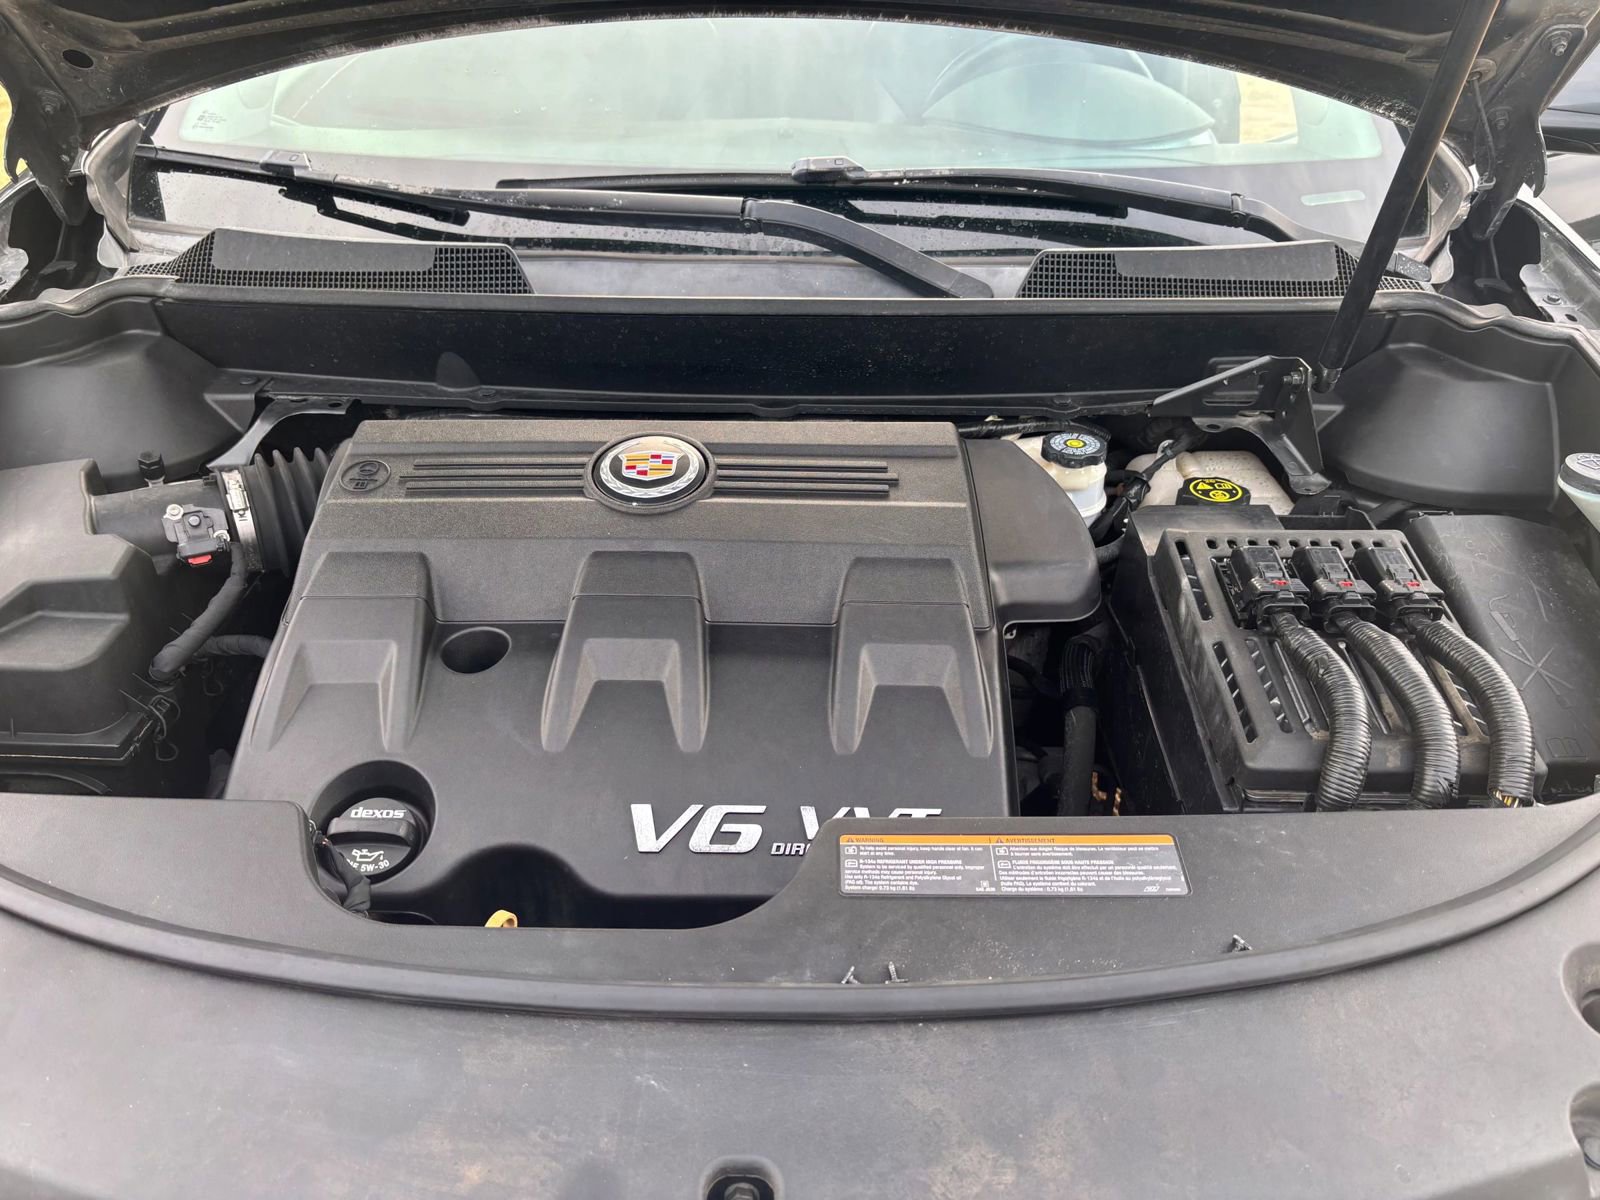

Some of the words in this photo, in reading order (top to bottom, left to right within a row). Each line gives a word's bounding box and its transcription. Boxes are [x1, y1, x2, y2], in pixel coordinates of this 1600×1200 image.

[350, 807, 407, 819] dexos
[631, 803, 767, 854] V6
[771, 842, 811, 856] DIR
[346, 858, 359, 869] AE
[360, 860, 390, 872] 5W-30
